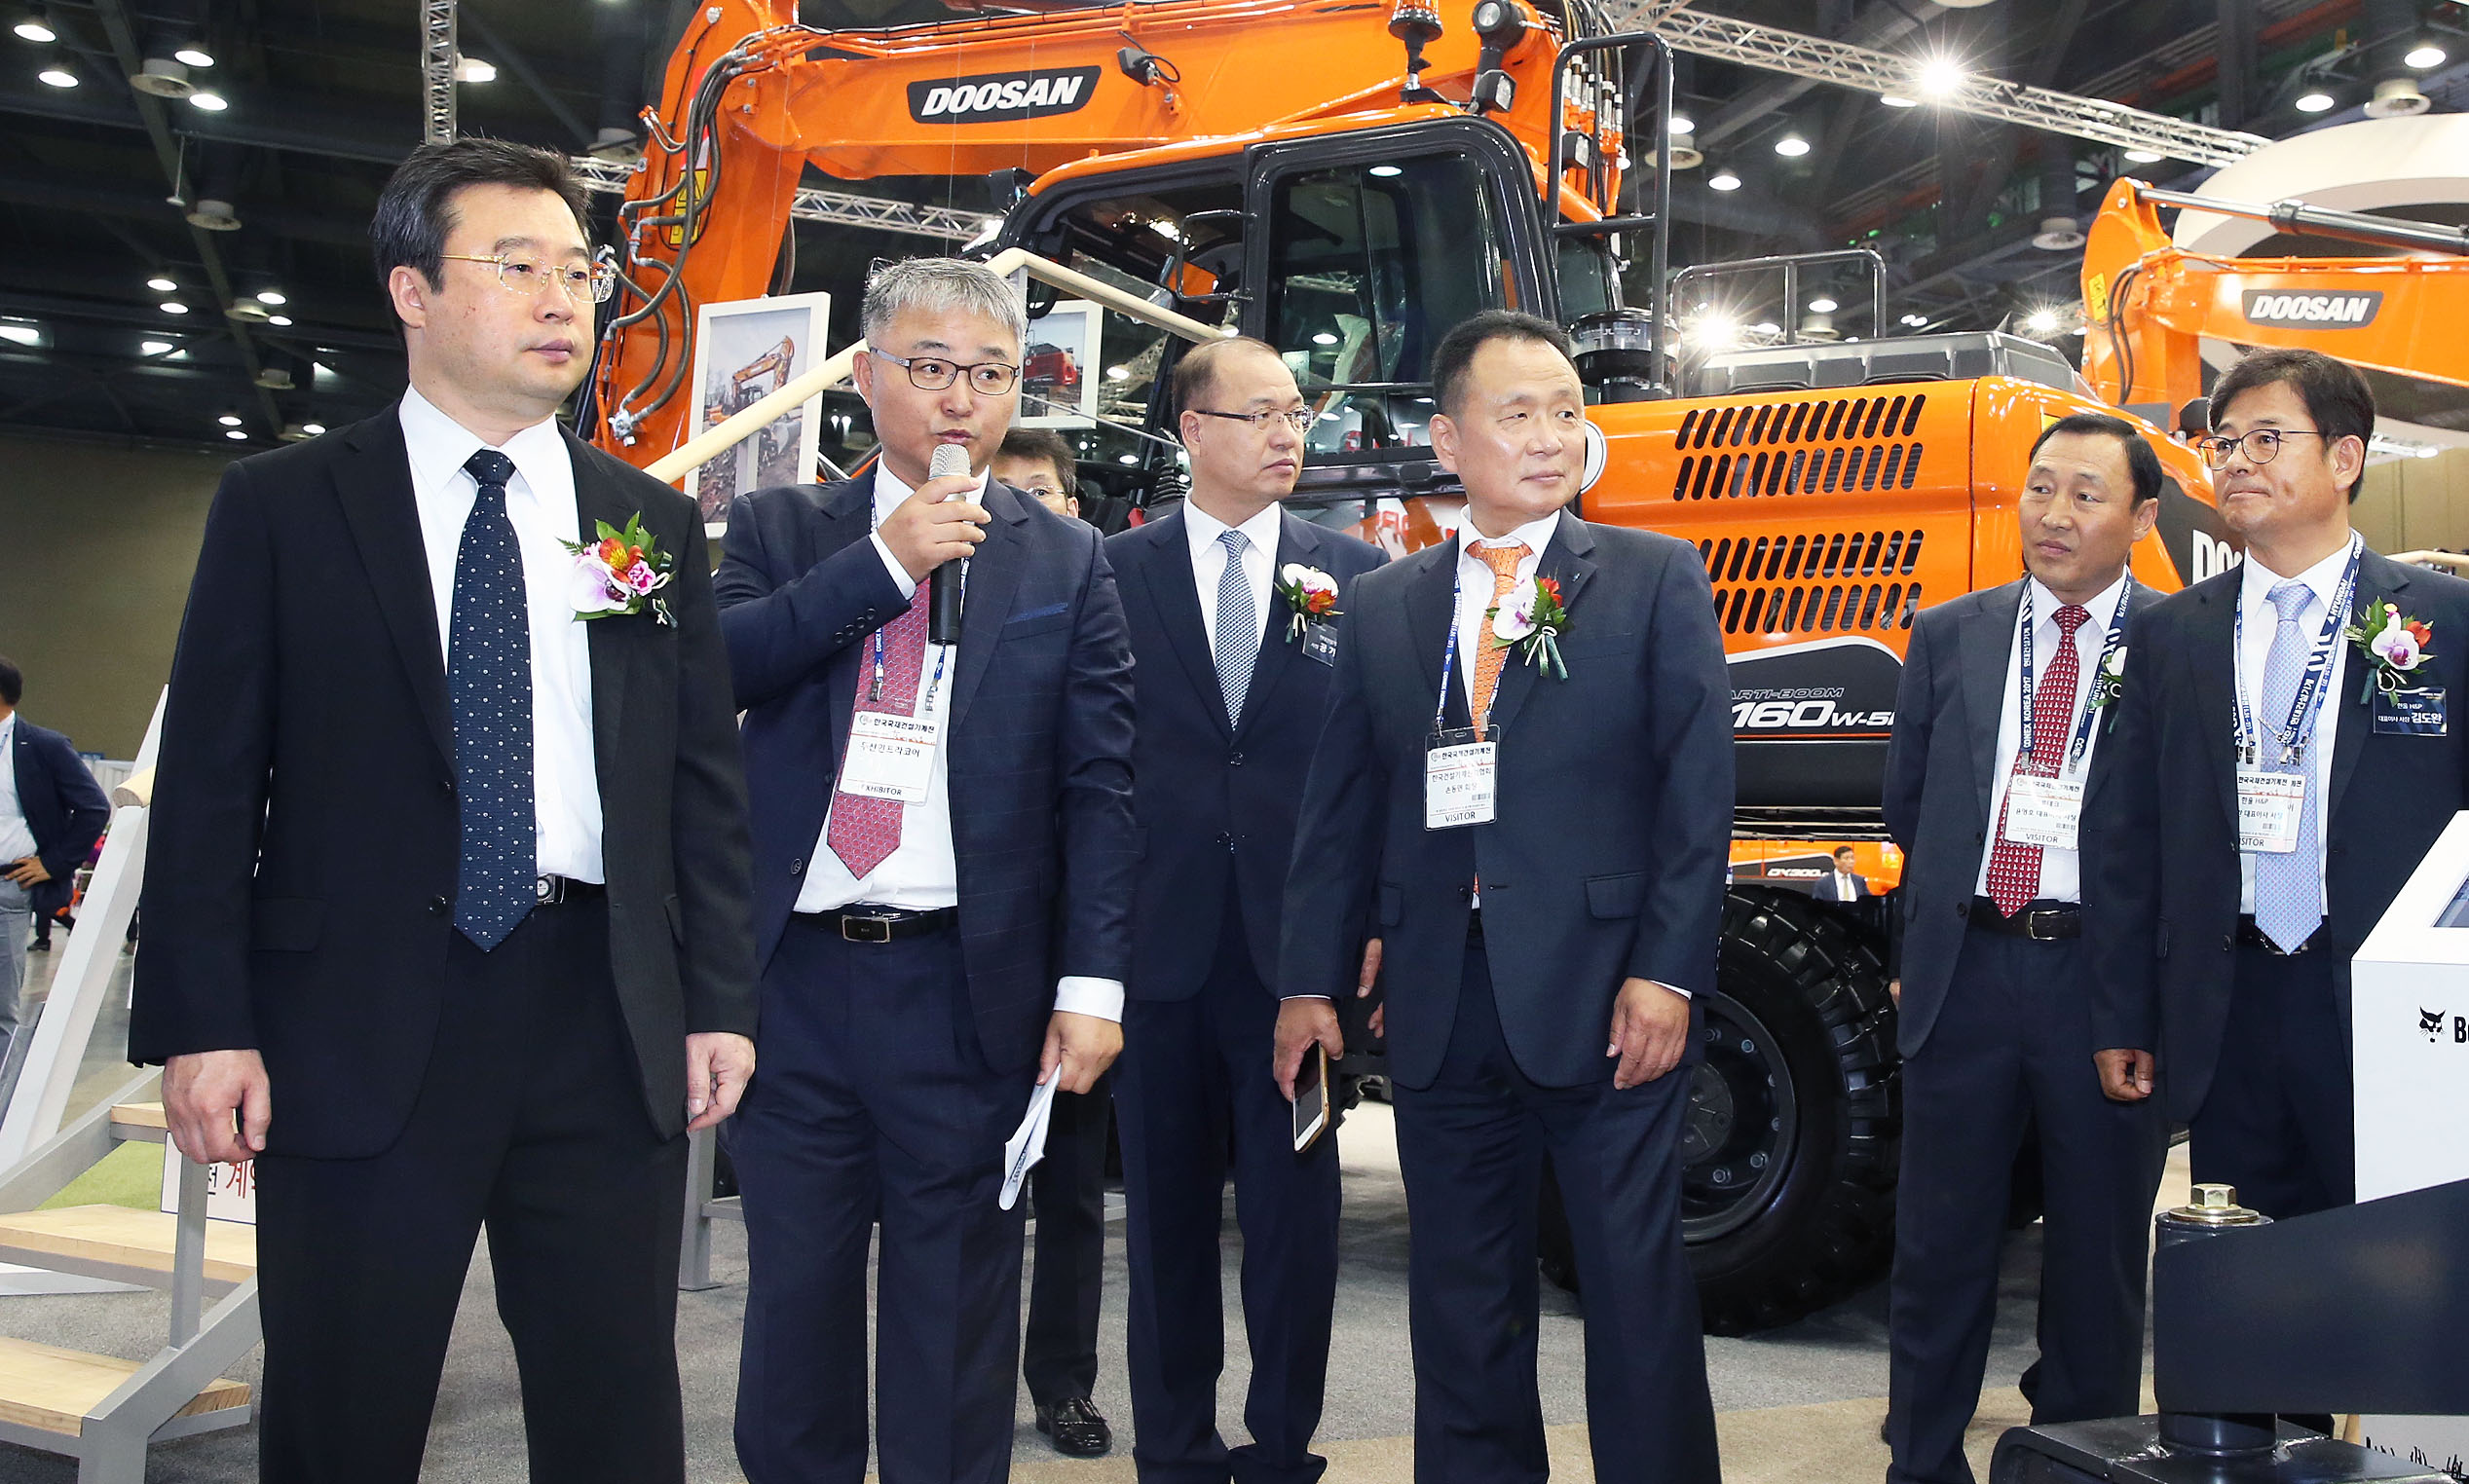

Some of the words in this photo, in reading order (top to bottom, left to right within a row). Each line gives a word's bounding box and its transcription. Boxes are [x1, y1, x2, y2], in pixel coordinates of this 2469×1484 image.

[920, 76, 1084, 116] DOOSAN
[2250, 295, 2371, 322] DOOSAN
[2330, 578, 2347, 617] HYUNDAI
[2023, 676, 2032, 692] 2017
[2023, 693, 2032, 721] KOREA
[874, 718, 935, 733] 한국국제건설기계전
[2411, 712, 2443, 724] 김도완
[2023, 722, 2032, 748] CONEX
[861, 741, 920, 758] 두산인프라코어
[861, 784, 902, 796] EXHIBITOR
[1444, 811, 1476, 823] VISITOR
[2026, 834, 2058, 843] VISITOR
[2454, 1016, 2469, 1043] B
